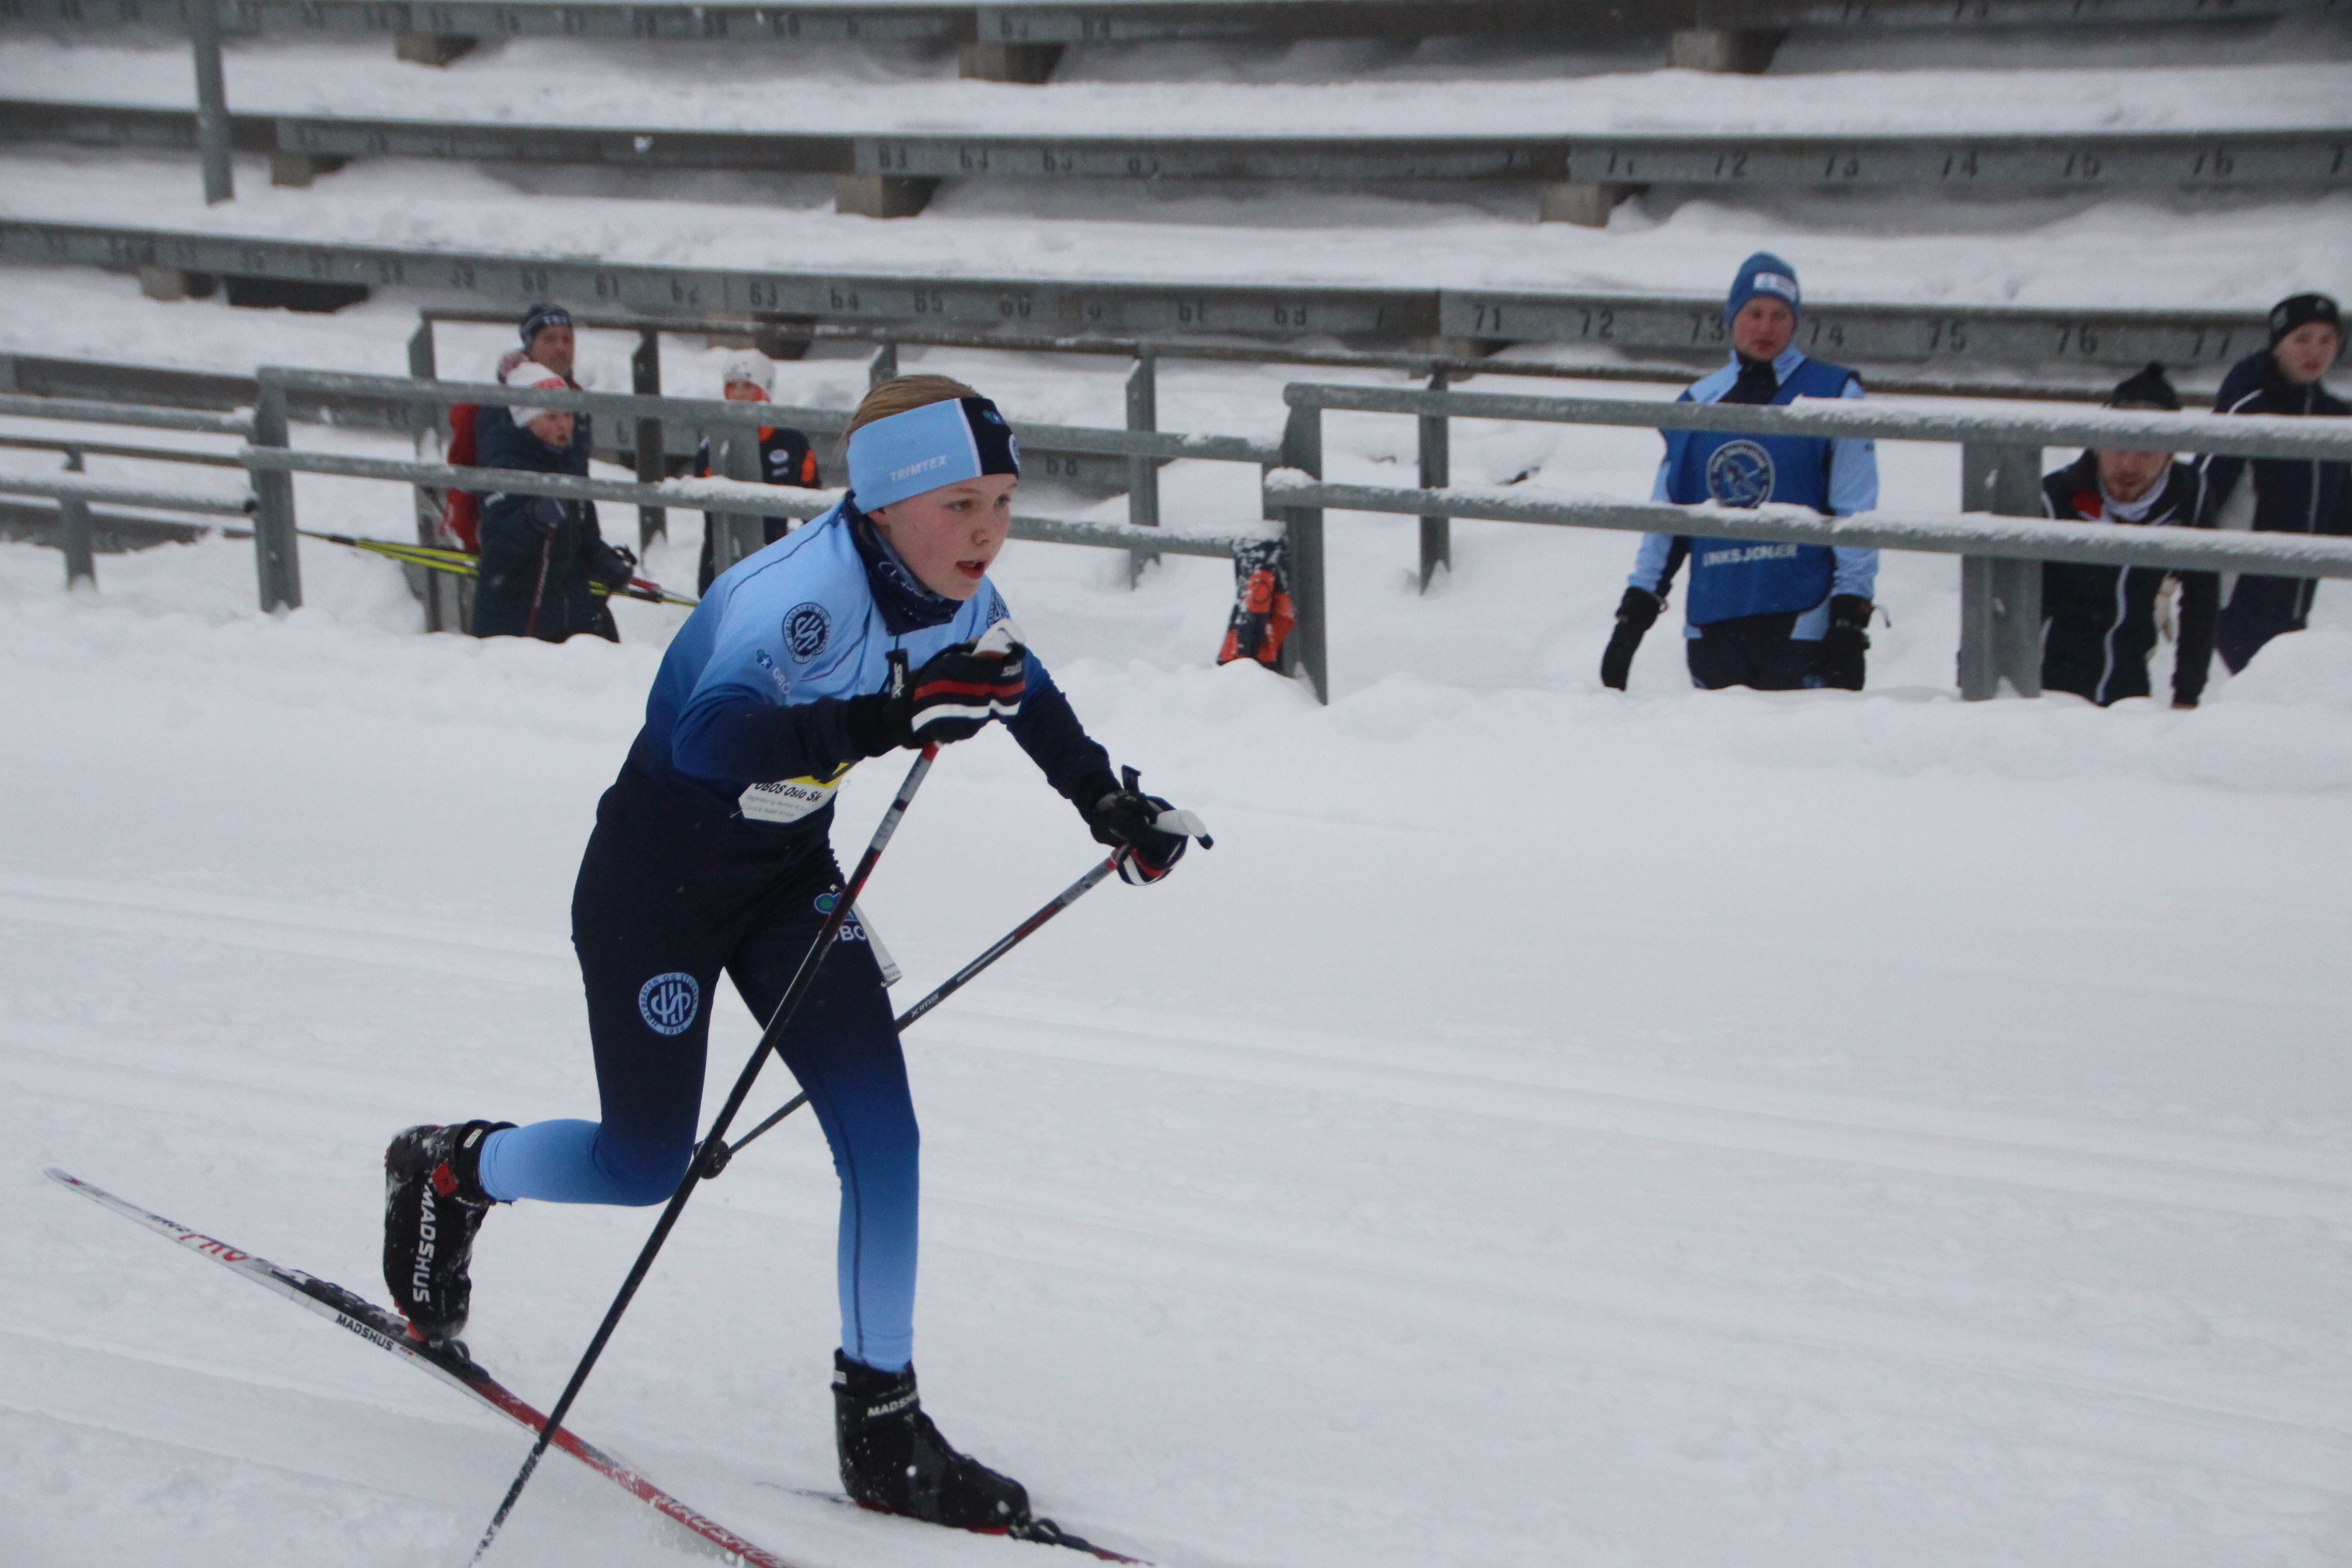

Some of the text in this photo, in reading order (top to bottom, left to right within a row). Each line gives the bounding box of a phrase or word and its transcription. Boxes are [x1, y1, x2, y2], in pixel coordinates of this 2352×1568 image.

[750, 281, 779, 309] 63
[1474, 305, 1501, 333] 71
[1580, 308, 1614, 338] 72
[1927, 319, 1966, 352] 75
[2057, 323, 2098, 356] 76
[890, 455, 947, 481] TRIMTEX
[784, 787, 807, 799] Oslo
[664, 1024, 686, 1034] 1916
[412, 1184, 436, 1303] MADSHUS
[336, 1314, 394, 1352] MADSHUS
